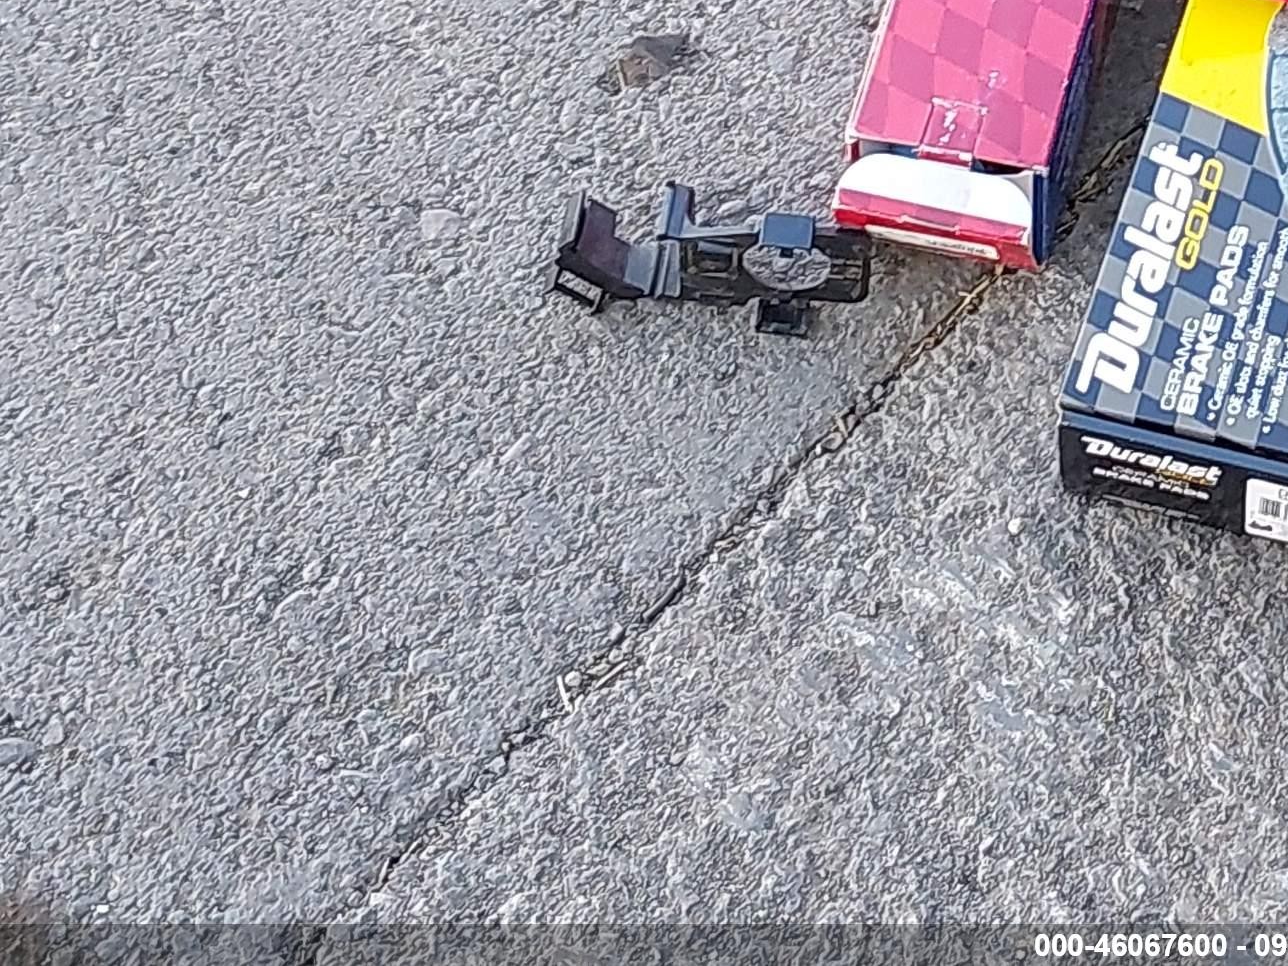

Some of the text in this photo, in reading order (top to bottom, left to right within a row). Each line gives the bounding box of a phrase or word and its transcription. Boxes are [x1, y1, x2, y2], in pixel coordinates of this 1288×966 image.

[1175, 157, 1224, 270] GOLD
[1075, 142, 1203, 394] Duralast
[1263, 268, 1280, 288] for
[1176, 225, 1249, 416] BRAKE PADS
[1208, 241, 1269, 410] Ceramic OE grade formulation
[1249, 289, 1275, 341] chamfers
[1160, 318, 1200, 411] CERAMIC
[1244, 341, 1259, 365] and
[1246, 335, 1281, 419] quiet stopping
[1234, 366, 1252, 393] slots
[1271, 370, 1288, 395] dust
[1227, 394, 1244, 415] OE
[1263, 395, 1281, 423] Low
[1080, 435, 1223, 482] Duralast
